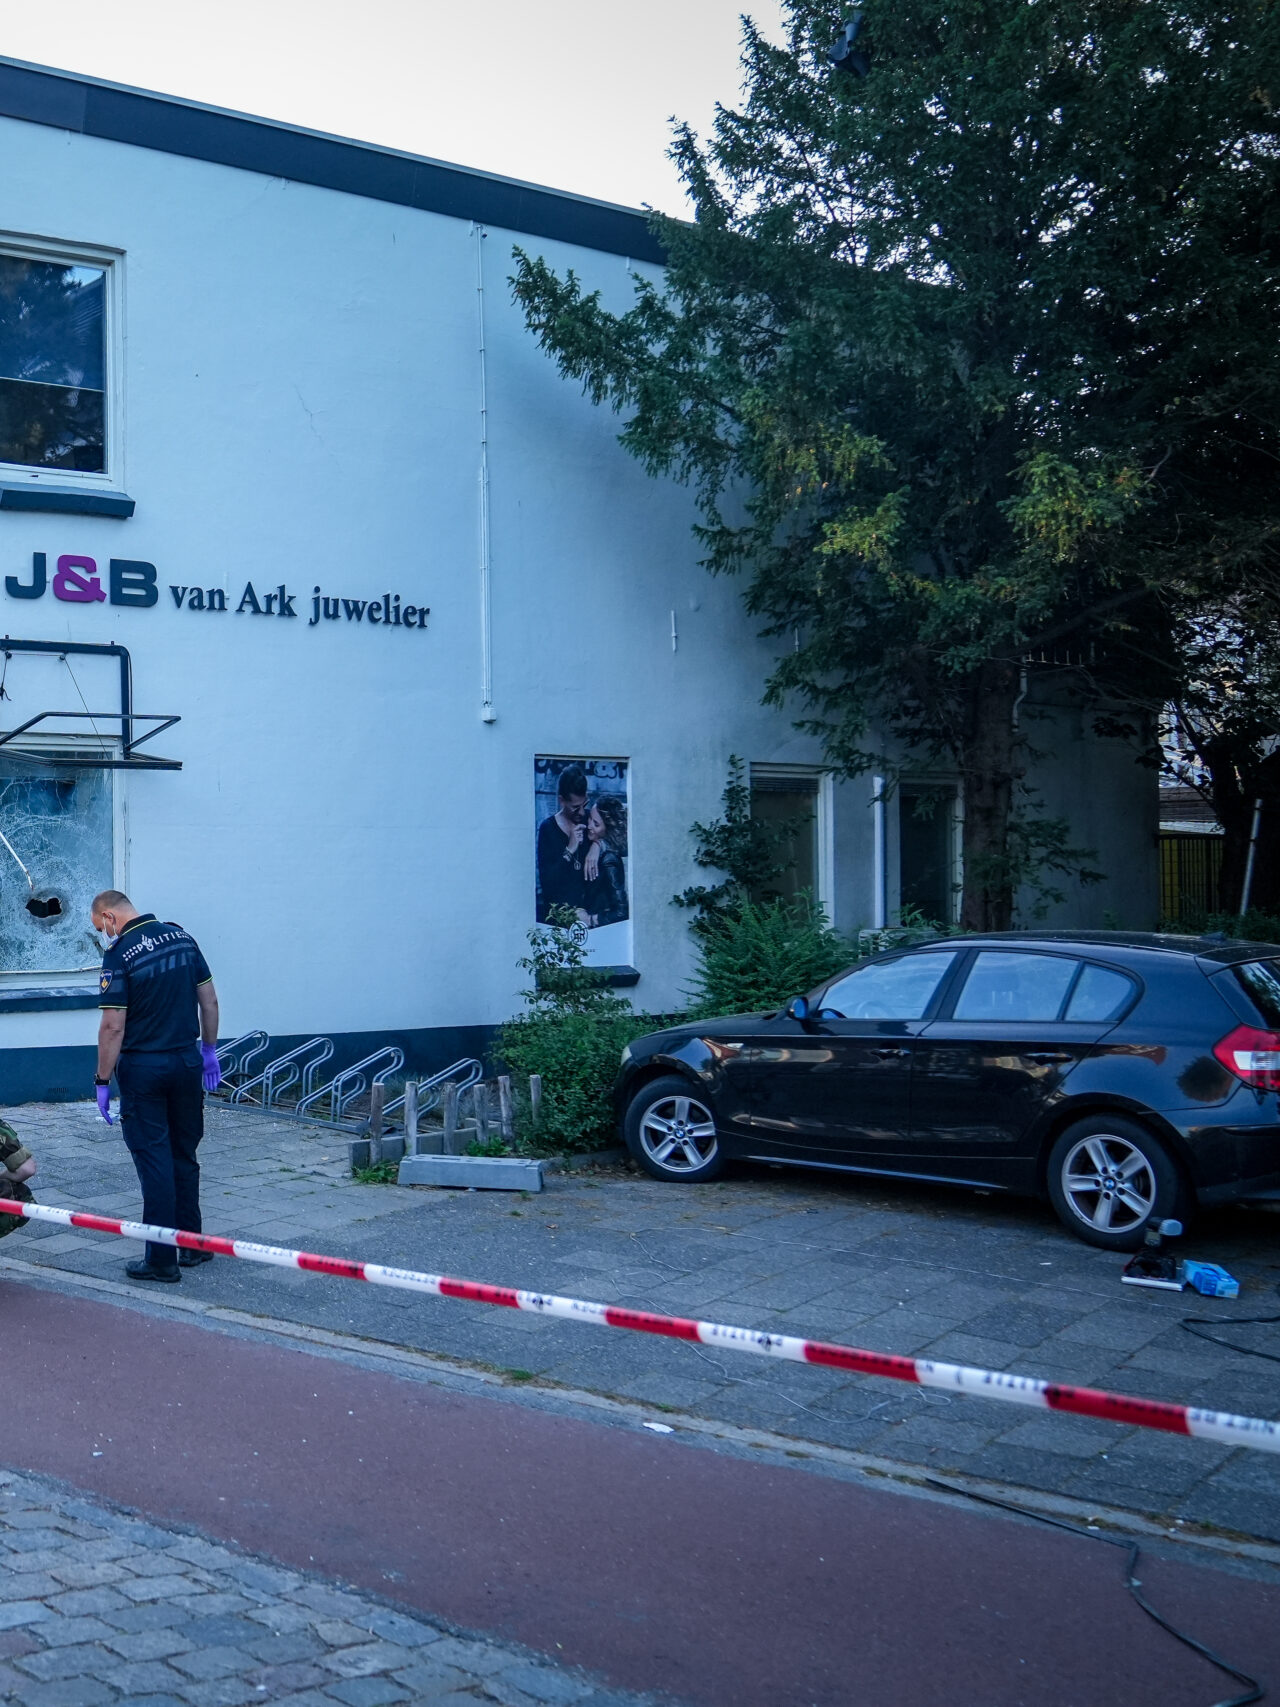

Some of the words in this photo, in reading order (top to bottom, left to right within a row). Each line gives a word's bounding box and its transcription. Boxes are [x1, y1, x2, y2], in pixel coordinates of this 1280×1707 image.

[5, 552, 159, 608] J&B
[169, 585, 228, 611] van
[235, 581, 298, 617] Ark
[309, 585, 431, 629] juwelier
[137, 931, 182, 951] POLITIE
